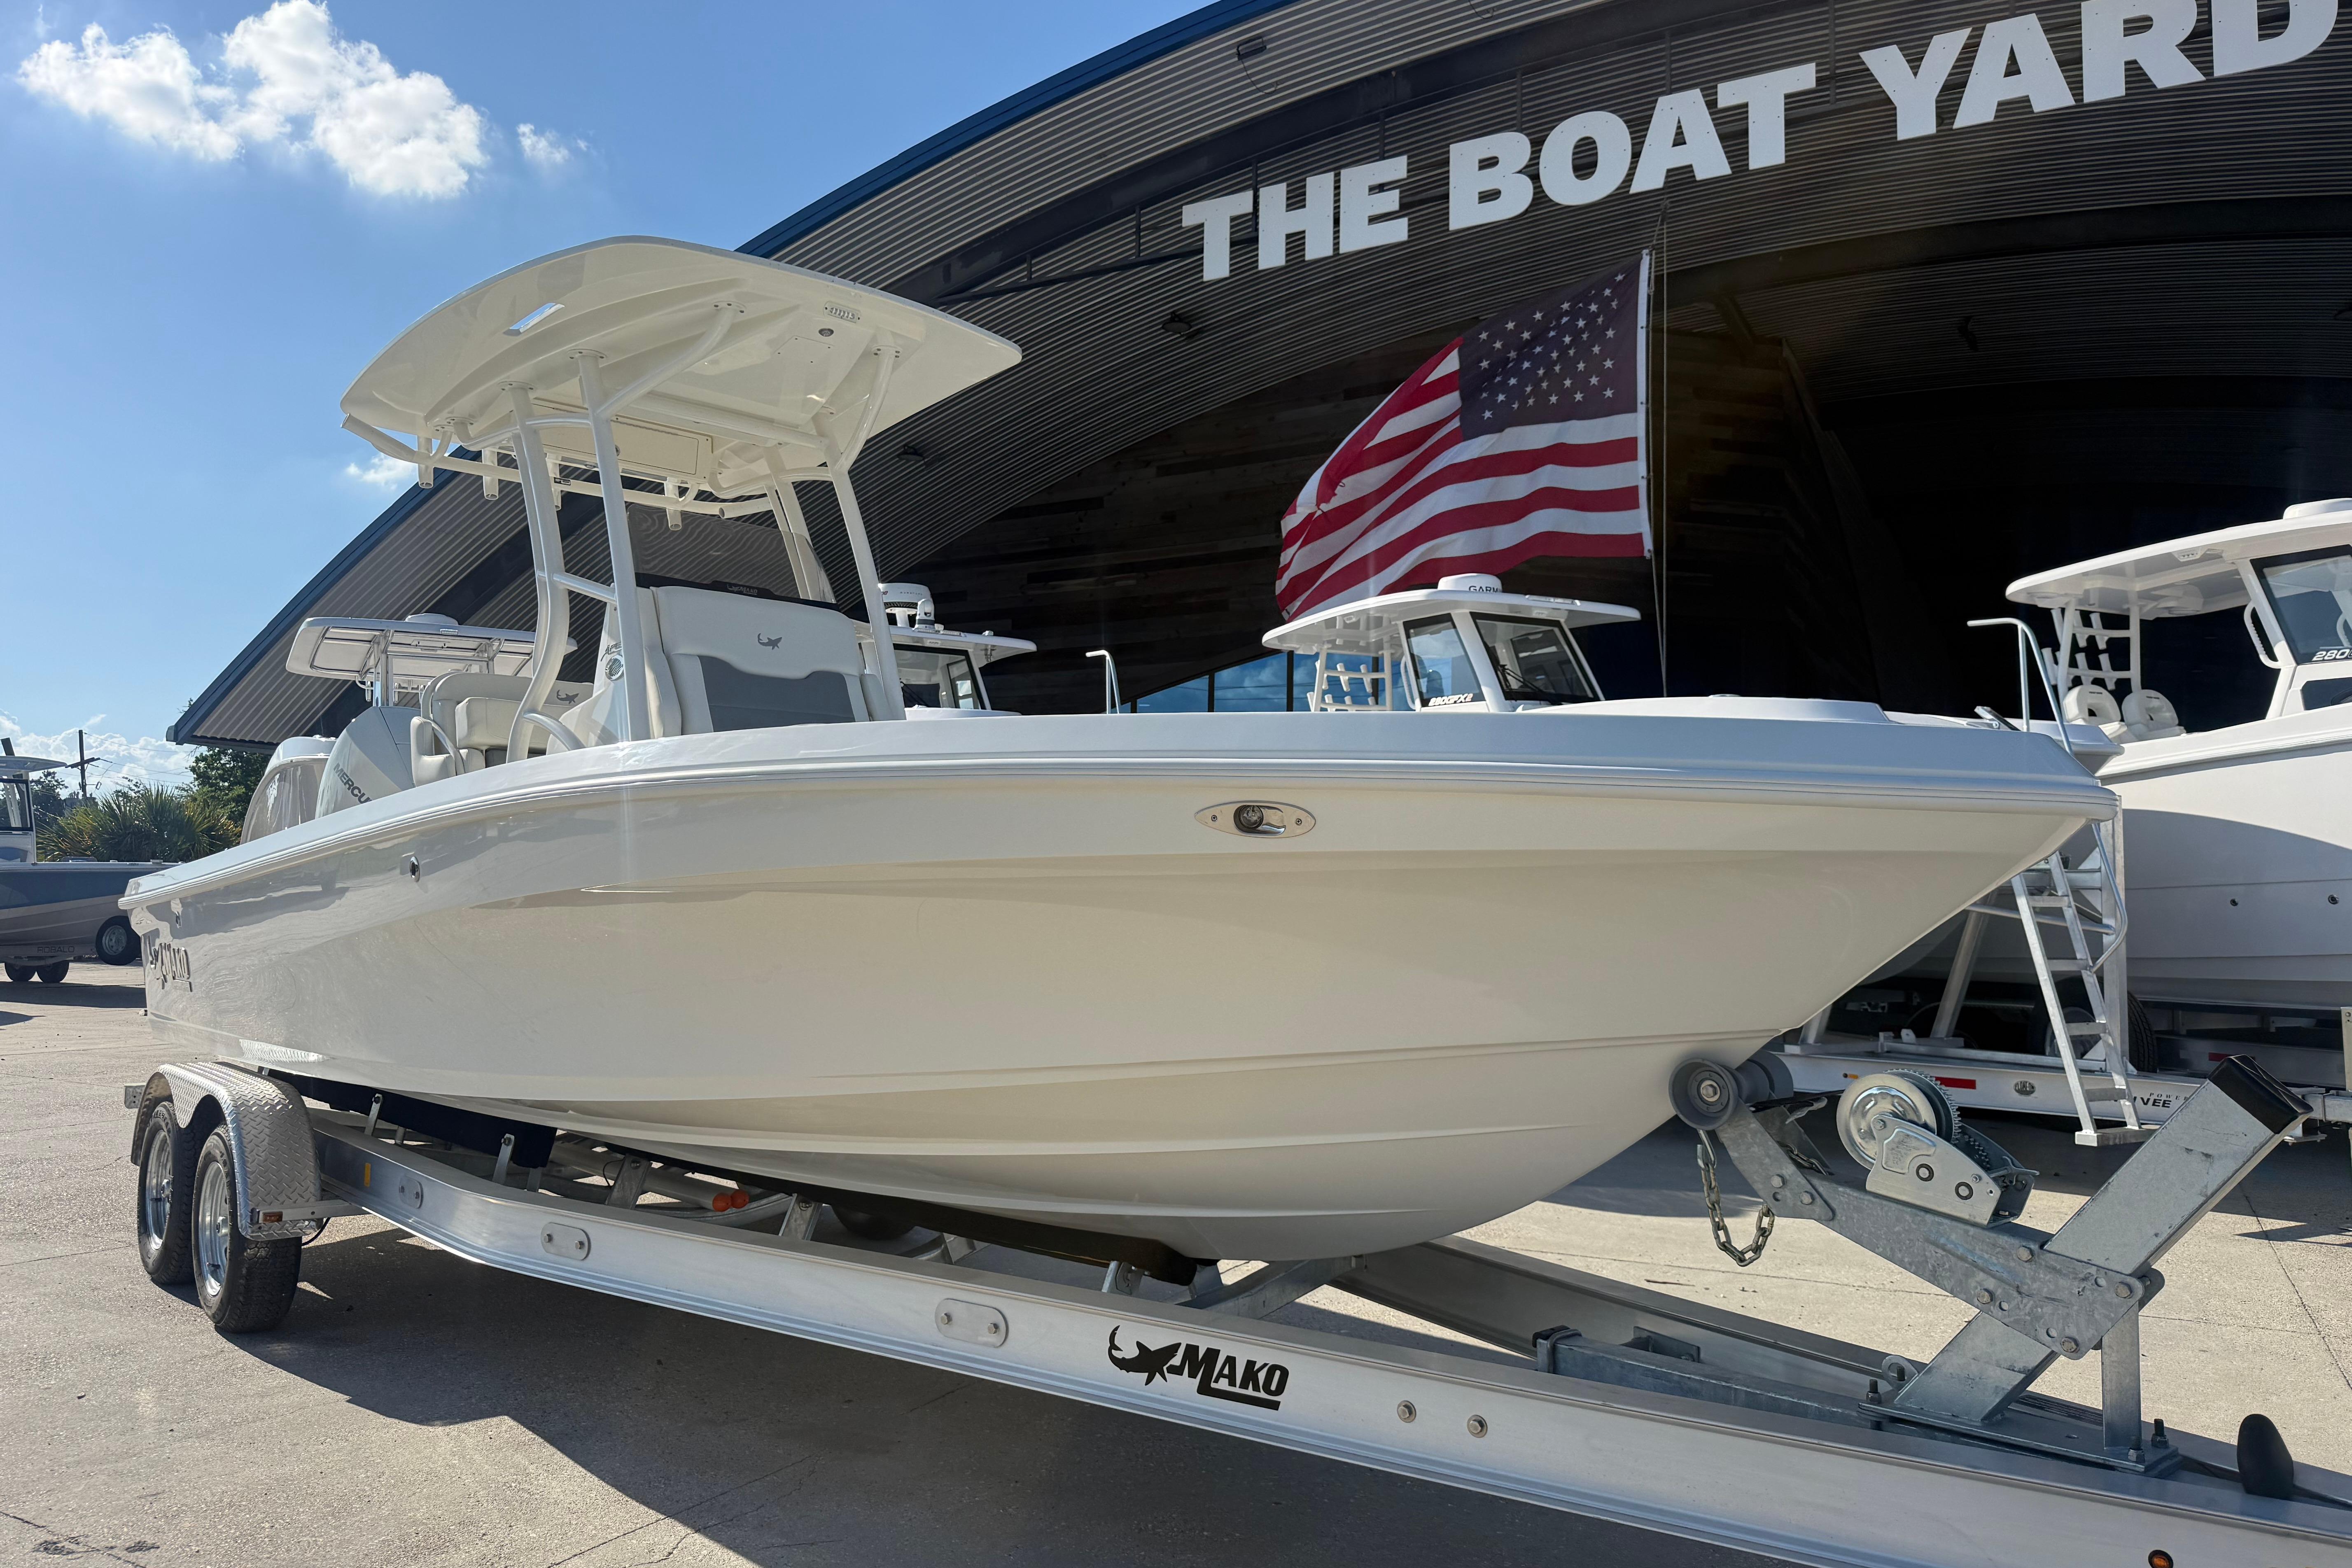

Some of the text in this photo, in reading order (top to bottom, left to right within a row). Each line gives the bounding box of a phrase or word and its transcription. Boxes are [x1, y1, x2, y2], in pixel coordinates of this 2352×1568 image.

[1182, 0, 2339, 281] THE BOAT YARD
[333, 762, 372, 804] MERCU
[1167, 1343, 1289, 1411] MAKO
